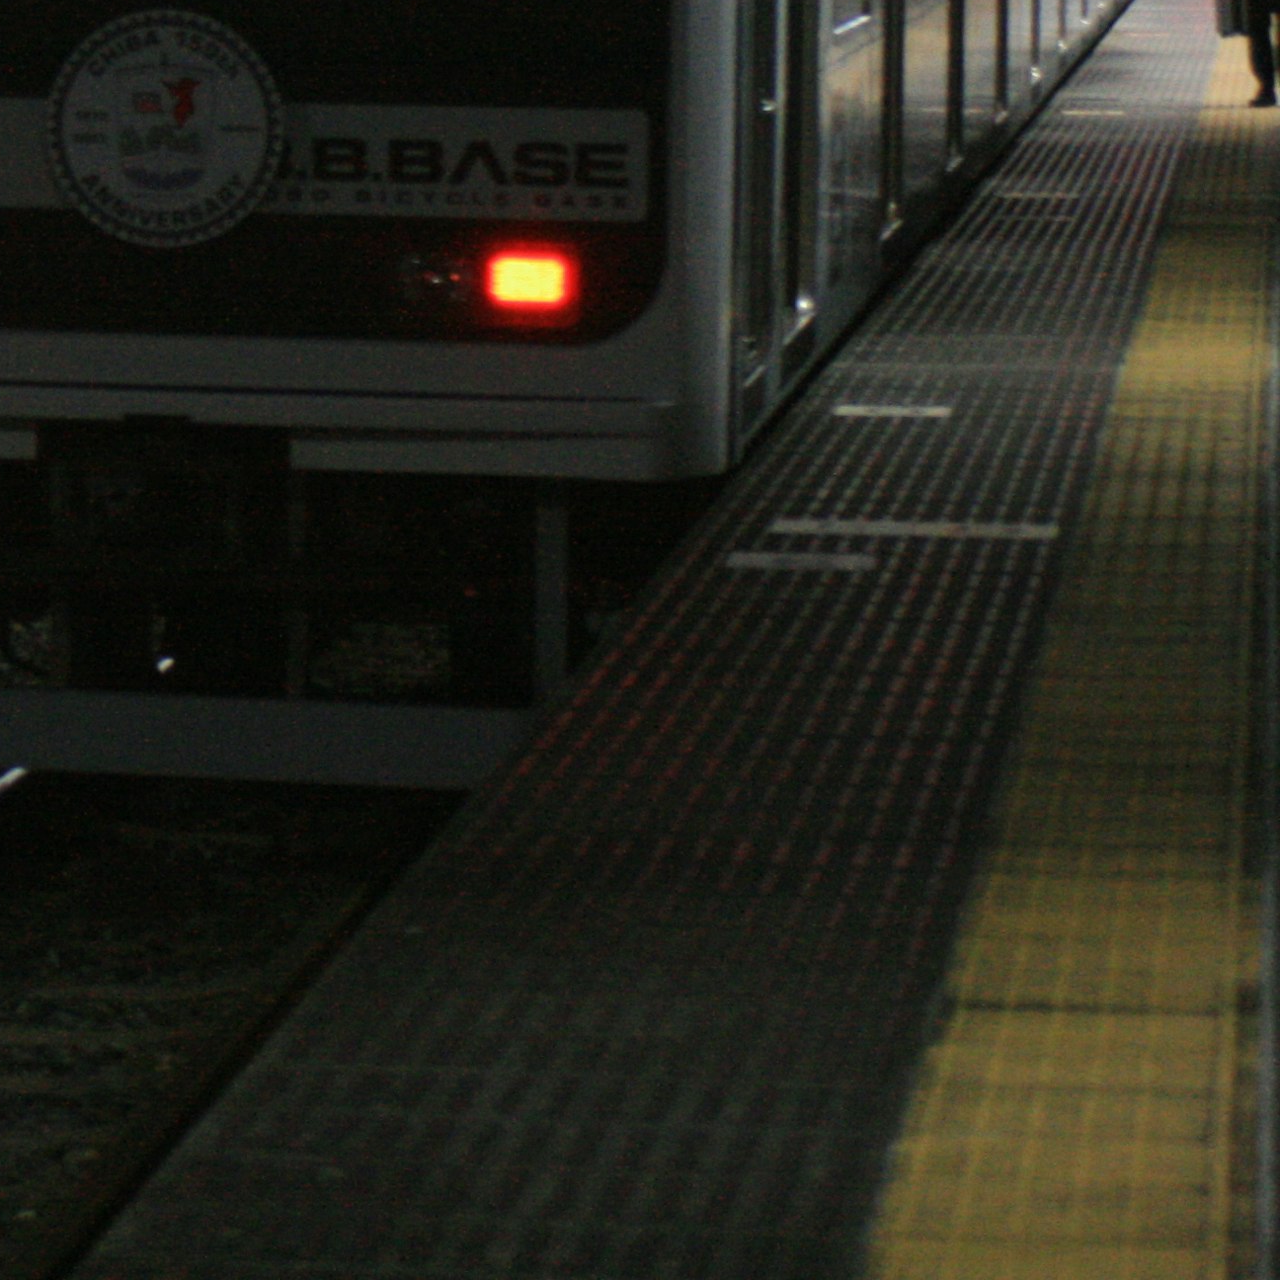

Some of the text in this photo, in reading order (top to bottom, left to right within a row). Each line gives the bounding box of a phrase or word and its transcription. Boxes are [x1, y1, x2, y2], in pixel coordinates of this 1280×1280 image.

[87, 30, 159, 76] CHIBA
[278, 137, 630, 188] .B.BASE
[81, 173, 244, 227] ANNIVERSARY
[264, 186, 330, 203] OSO
